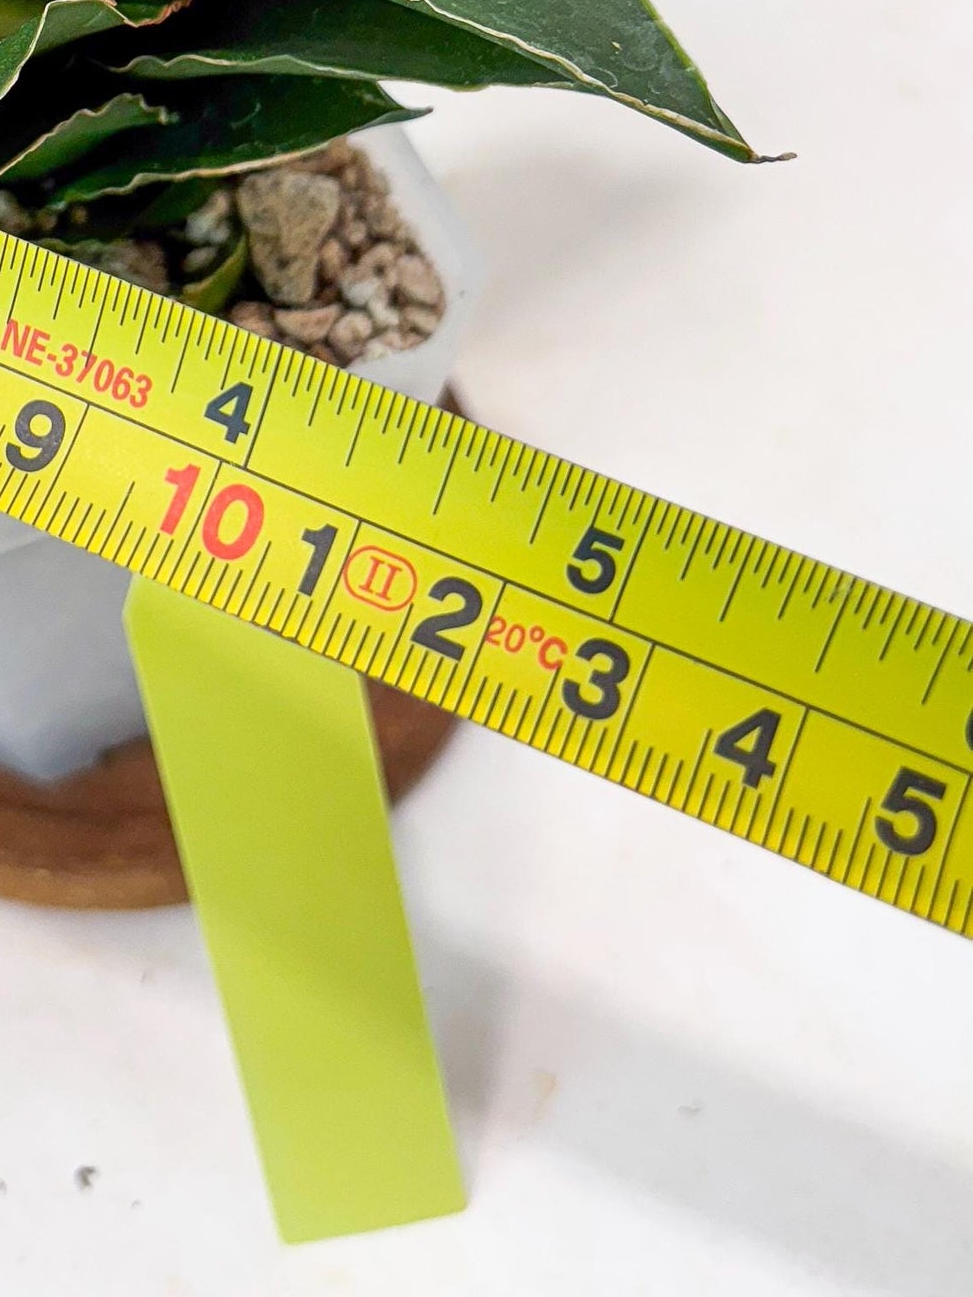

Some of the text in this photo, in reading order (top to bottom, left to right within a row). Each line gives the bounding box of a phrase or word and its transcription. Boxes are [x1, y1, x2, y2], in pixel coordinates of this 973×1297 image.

[5, 399, 66, 473] 9
[204, 381, 254, 444] 4
[159, 463, 265, 561] 10
[298, 523, 338, 597] 1
[566, 524, 625, 594] 5
[411, 576, 483, 662] 2
[562, 637, 631, 721] 3
[712, 707, 782, 790] 4
[874, 765, 947, 857] 5
